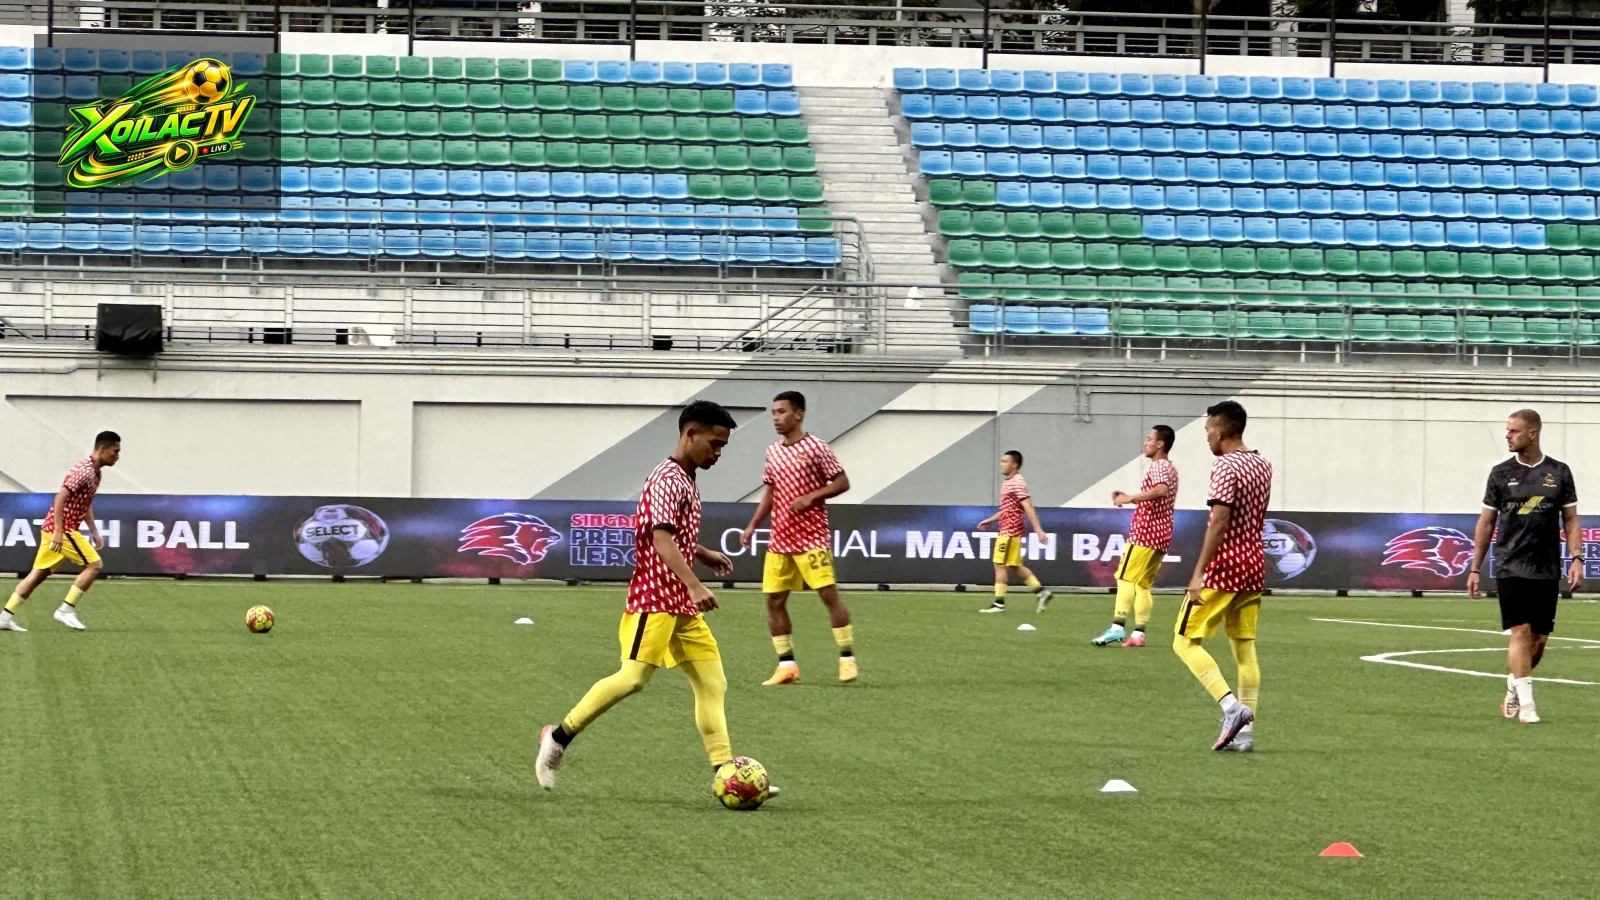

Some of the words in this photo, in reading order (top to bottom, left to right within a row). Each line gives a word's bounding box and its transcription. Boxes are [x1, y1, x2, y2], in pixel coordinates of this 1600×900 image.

[137, 520, 250, 549] BALL
[305, 524, 359, 538] SELECT
[808, 550, 830, 570] 22
